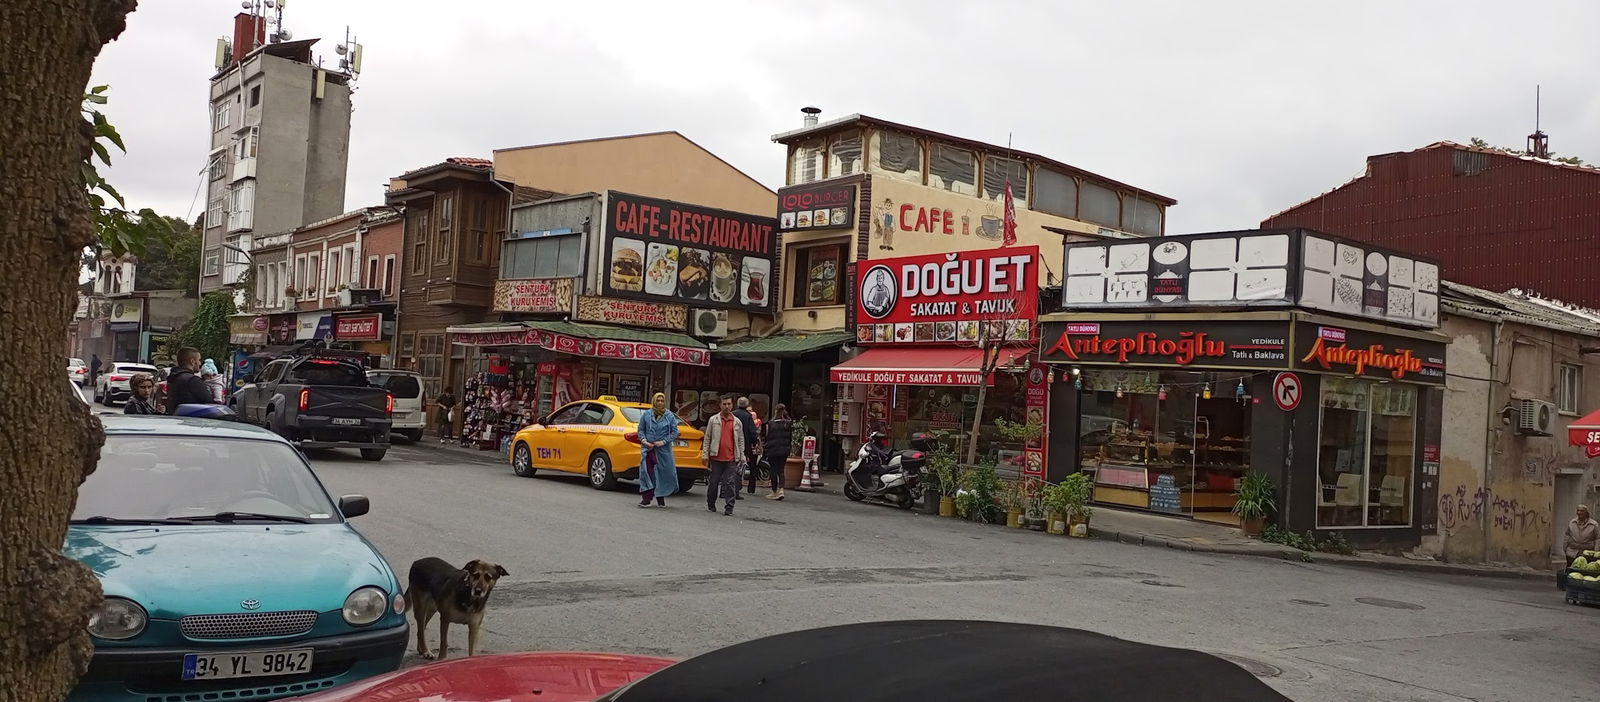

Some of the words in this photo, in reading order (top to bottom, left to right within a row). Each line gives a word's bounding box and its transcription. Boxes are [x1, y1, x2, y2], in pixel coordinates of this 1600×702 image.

[783, 194, 813, 211] LOLO
[615, 200, 773, 254] CAFE-RESTAURANT
[900, 204, 954, 235] CAFE
[902, 253, 983, 298] DOĞU
[989, 255, 1031, 293] ET
[910, 302, 957, 317] SAKATAT
[961, 303, 971, 314] &
[974, 299, 1015, 314] TAVUK
[1045, 331, 1226, 364] Anteplioğlu
[1232, 350, 1247, 359] Tatlı
[1254, 351, 1285, 360] Baklava
[1302, 337, 1422, 379] Anteplioğlu
[838, 373, 872, 382] YEDİKULE
[874, 372, 895, 383] DOĞU
[896, 374, 906, 383] ET
[909, 374, 943, 384] SAKATAT
[946, 375, 953, 383] &
[537, 447, 551, 459] TEH
[553, 448, 561, 459] 71
[197, 657, 219, 677] 34
[232, 656, 251, 675] YL
[263, 652, 308, 673] 9842
